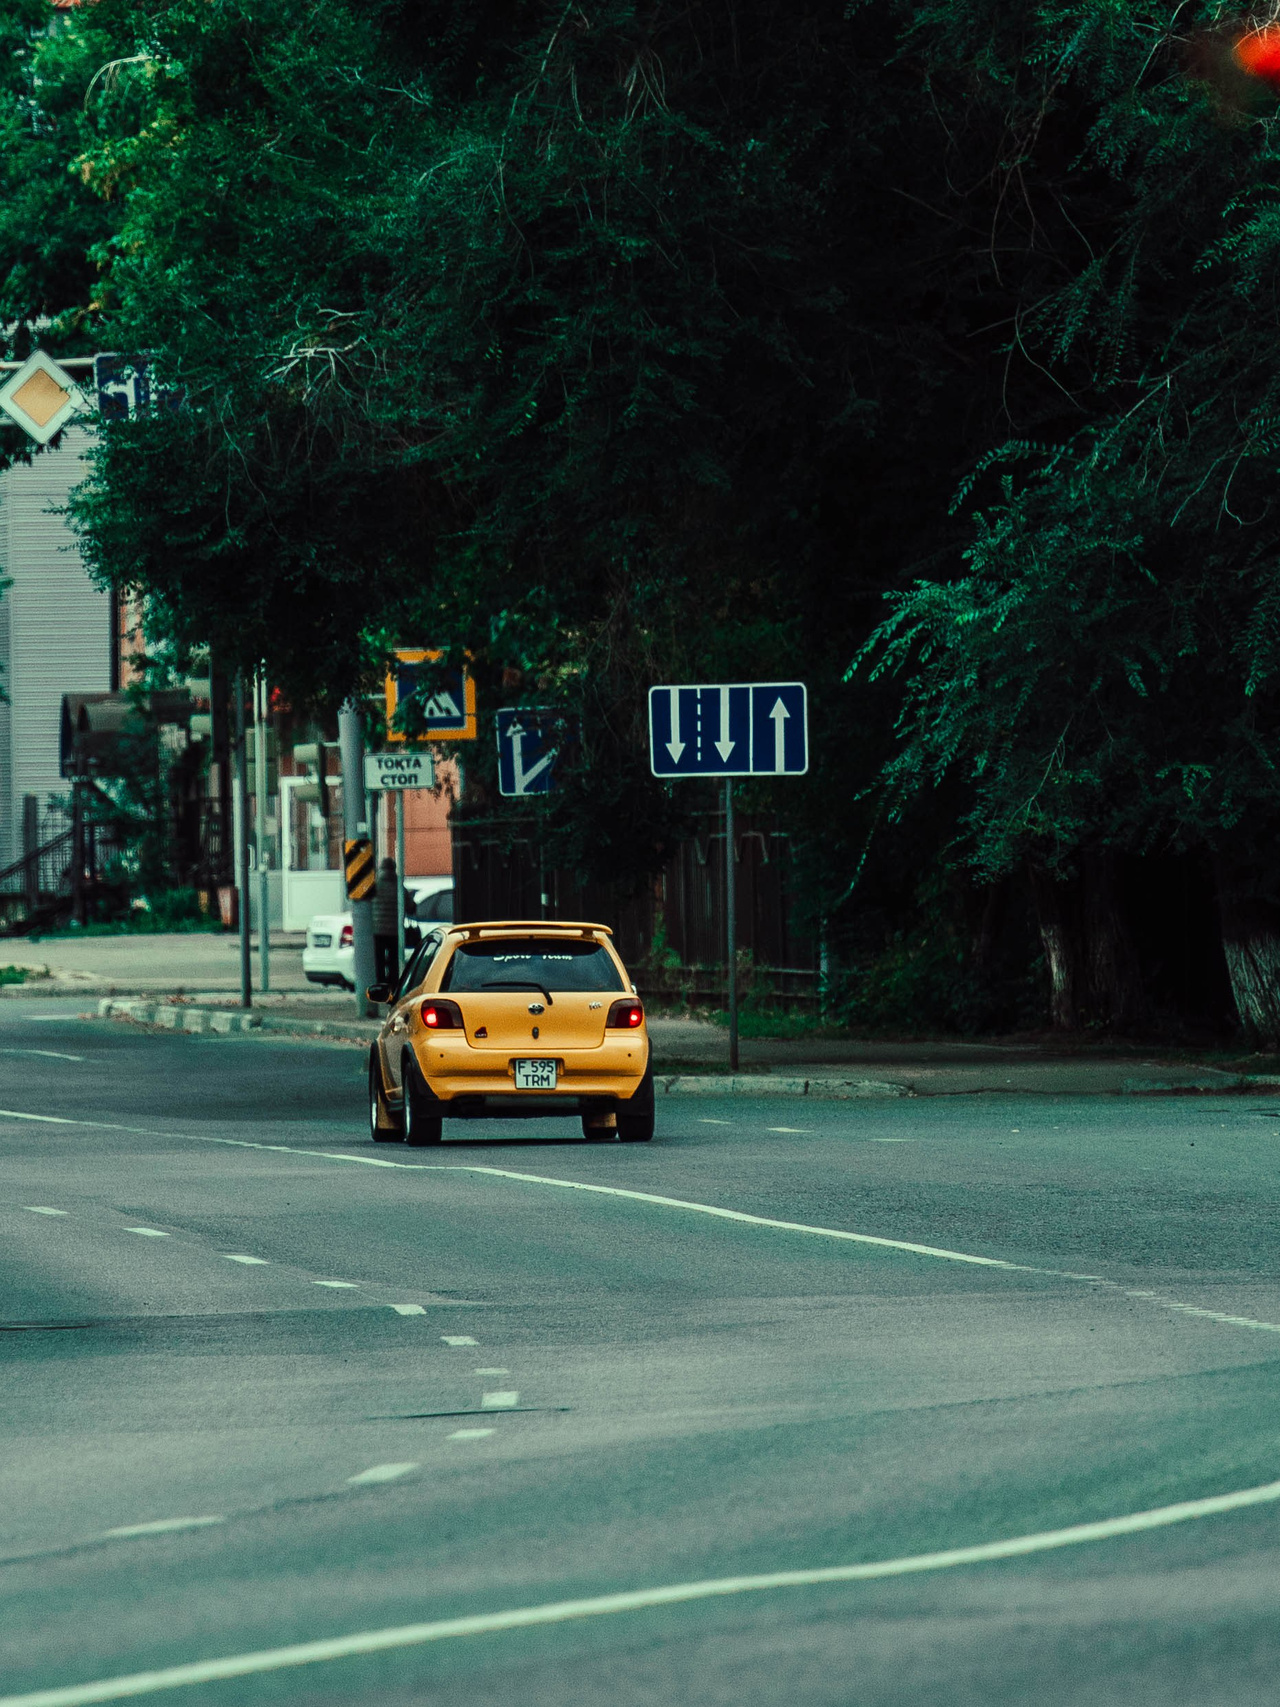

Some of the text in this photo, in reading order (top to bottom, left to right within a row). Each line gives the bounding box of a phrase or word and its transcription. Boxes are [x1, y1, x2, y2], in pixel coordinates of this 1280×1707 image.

[377, 757, 422, 772] ТОҚТА
[380, 774, 418, 786] СТОП
[518, 1061, 554, 1075] F 595
[523, 1074, 550, 1087] TRM
